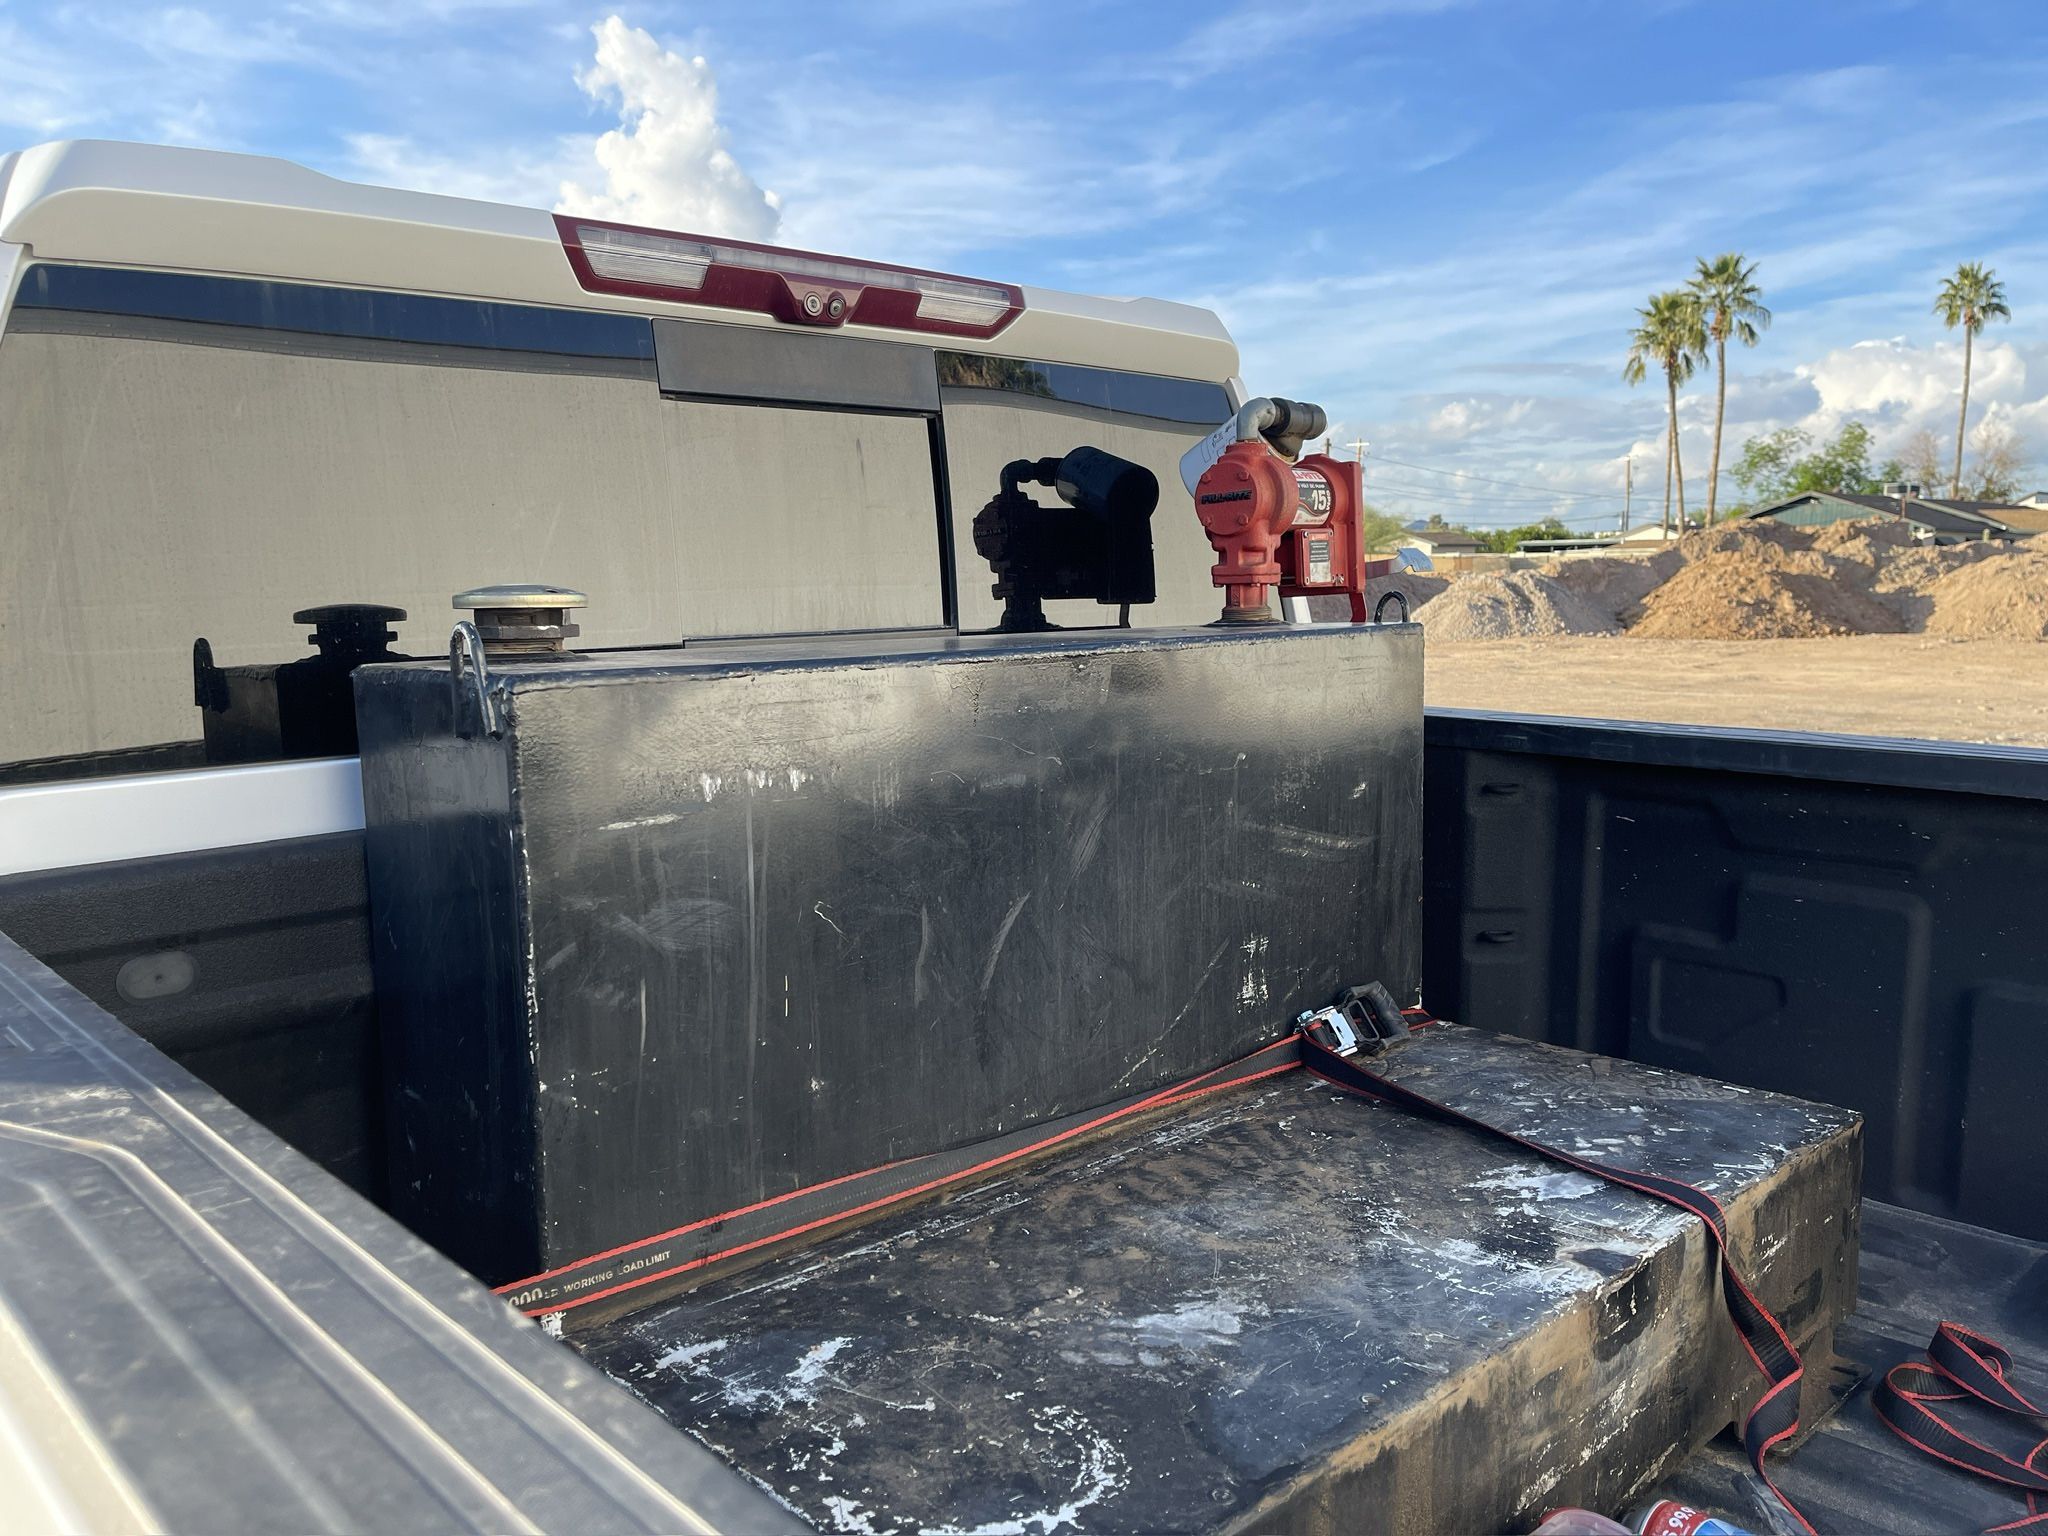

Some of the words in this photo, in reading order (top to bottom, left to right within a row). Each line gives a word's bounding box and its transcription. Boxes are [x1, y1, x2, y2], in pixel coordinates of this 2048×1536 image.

[1201, 489, 1252, 504] FILL-RITE
[1312, 490, 1326, 510] 15
[563, 1270, 614, 1293] WORKING
[618, 1260, 644, 1276] LOAD
[645, 1250, 671, 1267] LIMIT
